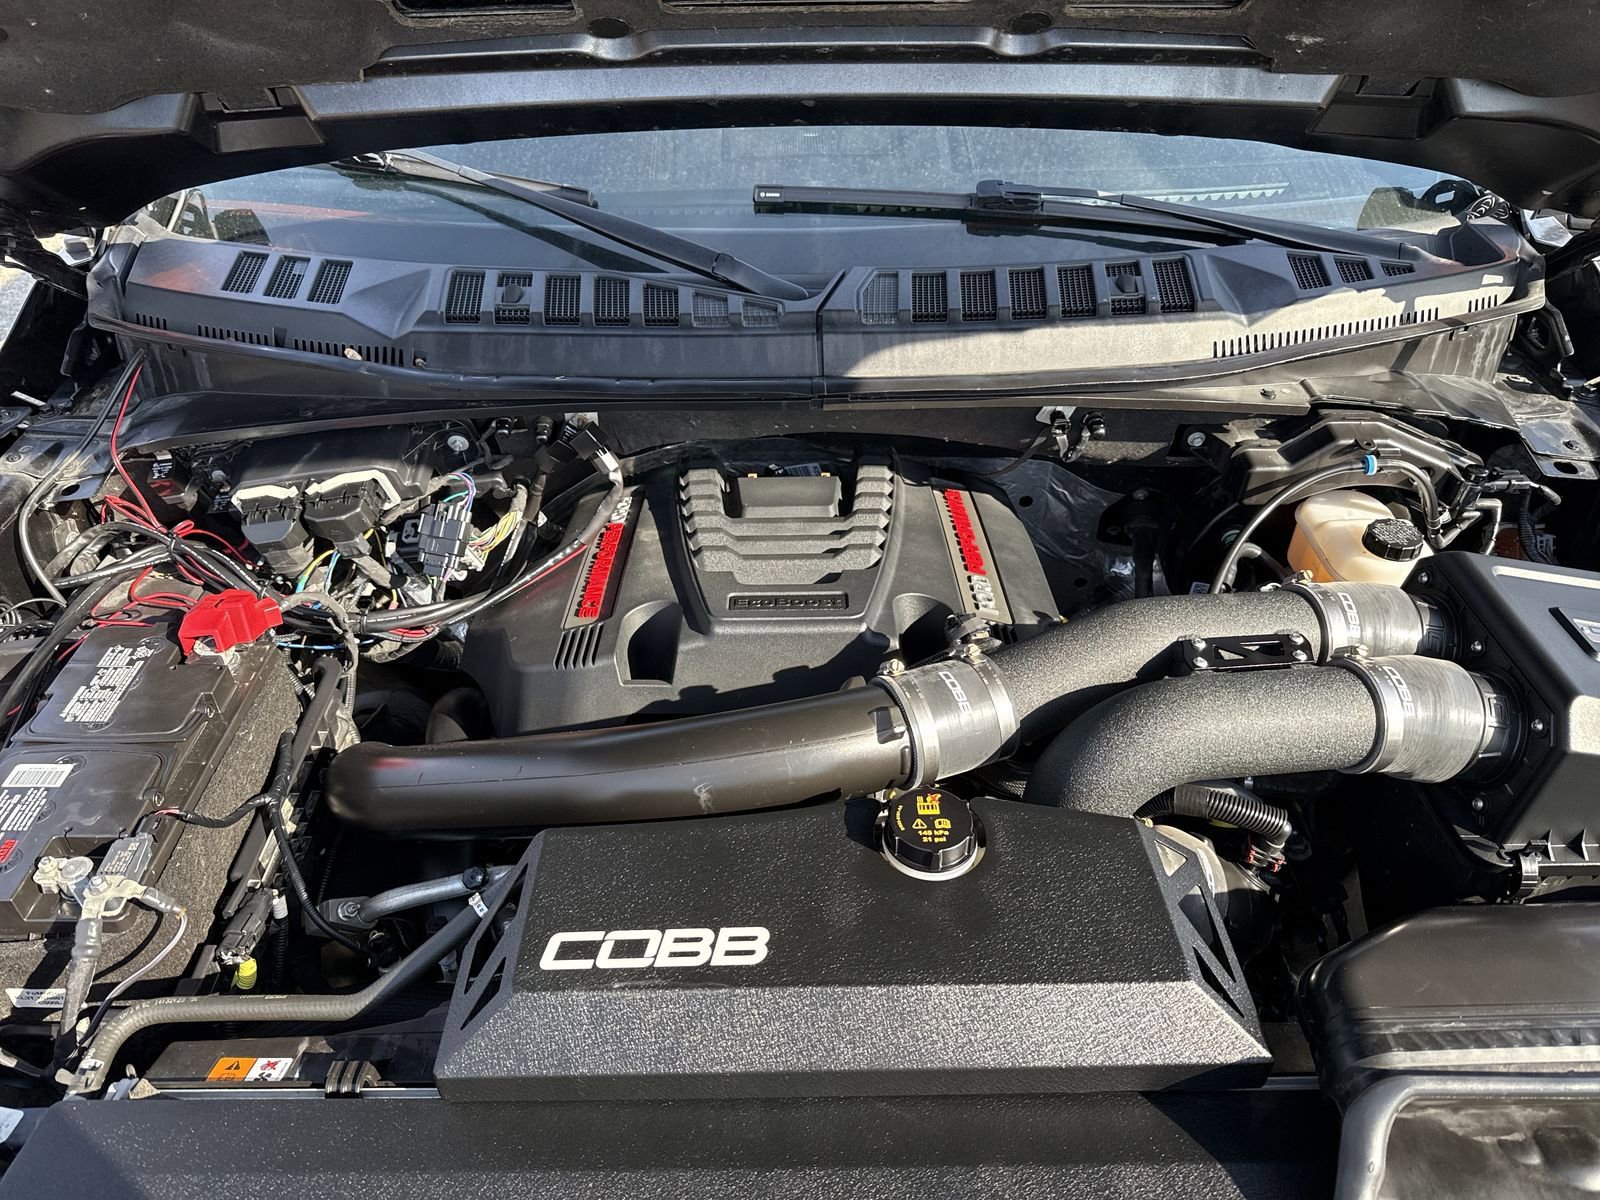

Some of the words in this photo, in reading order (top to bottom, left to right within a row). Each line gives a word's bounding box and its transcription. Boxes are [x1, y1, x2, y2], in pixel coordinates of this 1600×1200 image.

[943, 488, 986, 575] PERFORMANCE
[579, 522, 625, 618] PERFORMANCE
[971, 575, 999, 615] FORD
[1338, 592, 1360, 638] COBB
[938, 671, 971, 714] COBB
[1381, 666, 1415, 716] COBB
[539, 926, 770, 970] COBB
